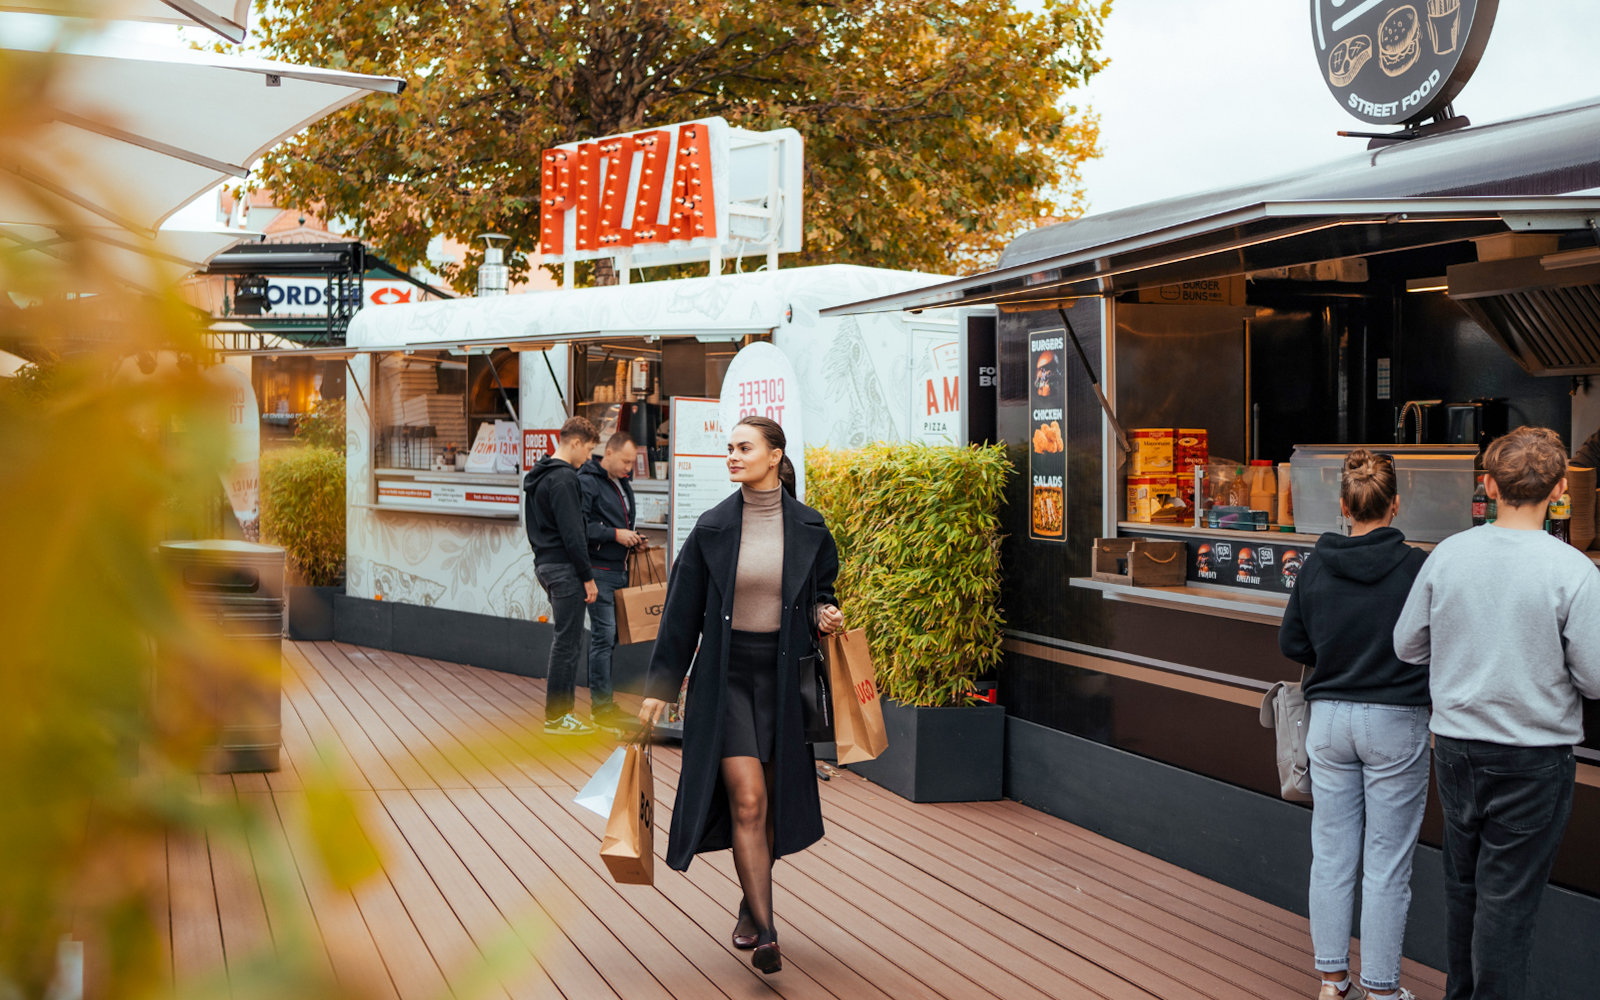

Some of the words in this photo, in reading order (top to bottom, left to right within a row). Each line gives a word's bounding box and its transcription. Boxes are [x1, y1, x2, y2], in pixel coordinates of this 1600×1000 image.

[1348, 92, 1399, 117] STREET
[1402, 69, 1441, 111] FOOD
[541, 123, 716, 255] PIZZA
[1182, 291, 1208, 301] BUNS
[1031, 337, 1064, 352] BURGERS
[926, 376, 959, 416] AM
[1033, 408, 1063, 421] CHICKEN
[924, 422, 947, 432] PIZZA
[525, 434, 548, 448] ORDER
[678, 461, 691, 470] PIZZA
[1033, 475, 1063, 488] SALADS
